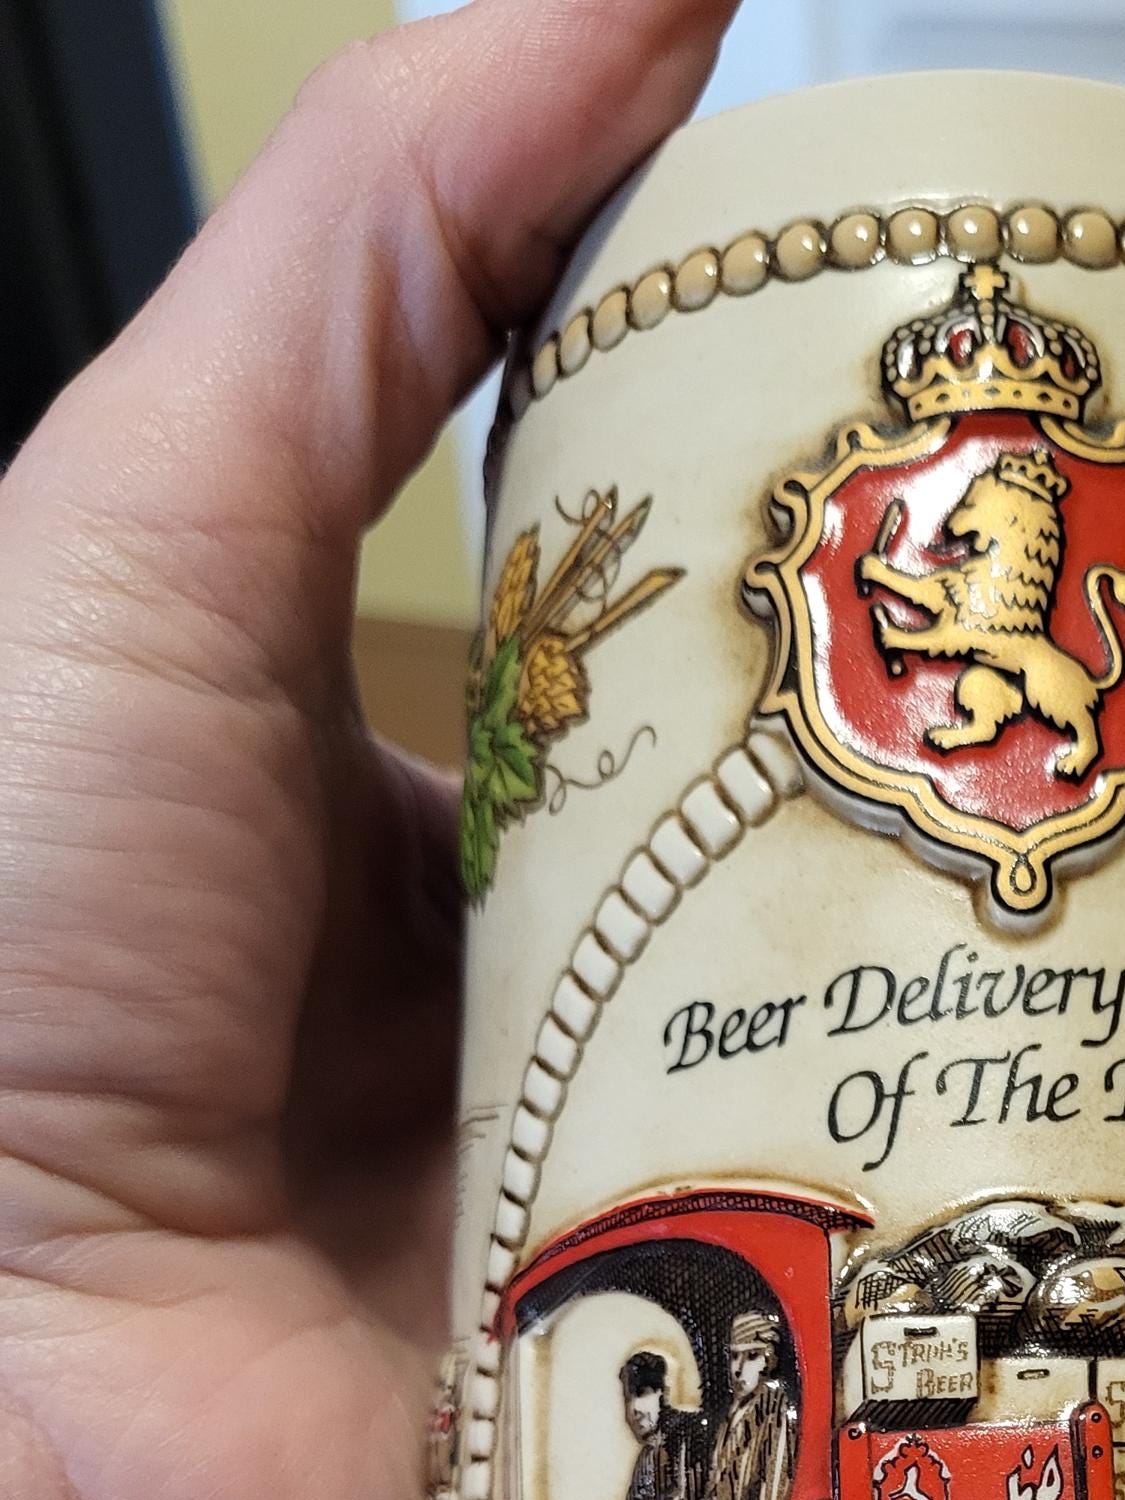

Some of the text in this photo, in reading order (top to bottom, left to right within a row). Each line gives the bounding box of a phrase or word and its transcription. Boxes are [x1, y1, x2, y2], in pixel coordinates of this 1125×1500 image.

[663, 991, 806, 1074] Beer
[826, 1052, 929, 1172] Of
[936, 1043, 1082, 1128] The
